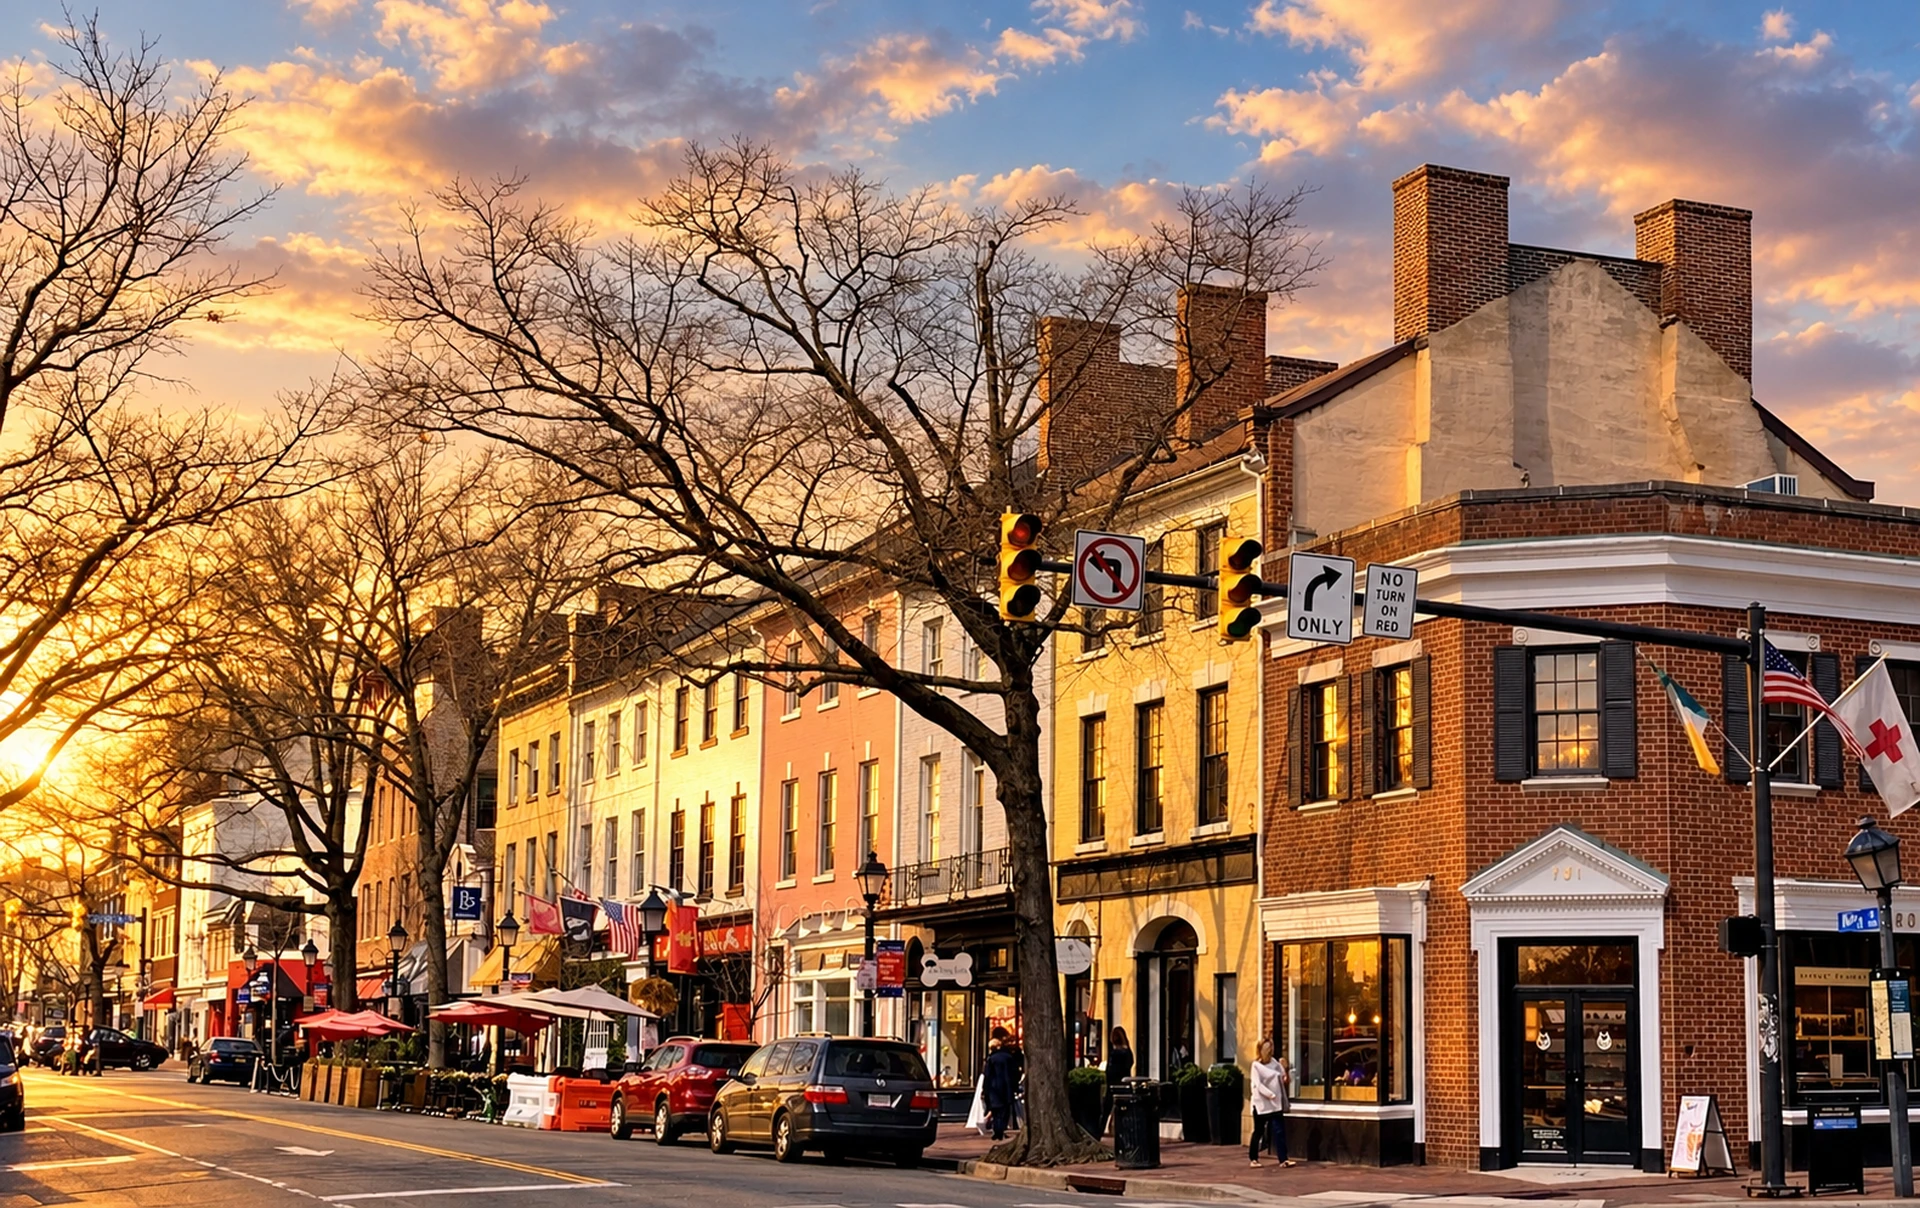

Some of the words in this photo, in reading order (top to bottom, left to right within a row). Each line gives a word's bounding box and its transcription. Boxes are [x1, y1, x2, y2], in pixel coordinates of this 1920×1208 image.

[1380, 572, 1403, 587] NO
[1376, 589, 1406, 602] TURN
[1381, 605, 1398, 617] ON
[1297, 616, 1343, 635] ONLY
[1376, 620, 1399, 633] RED
